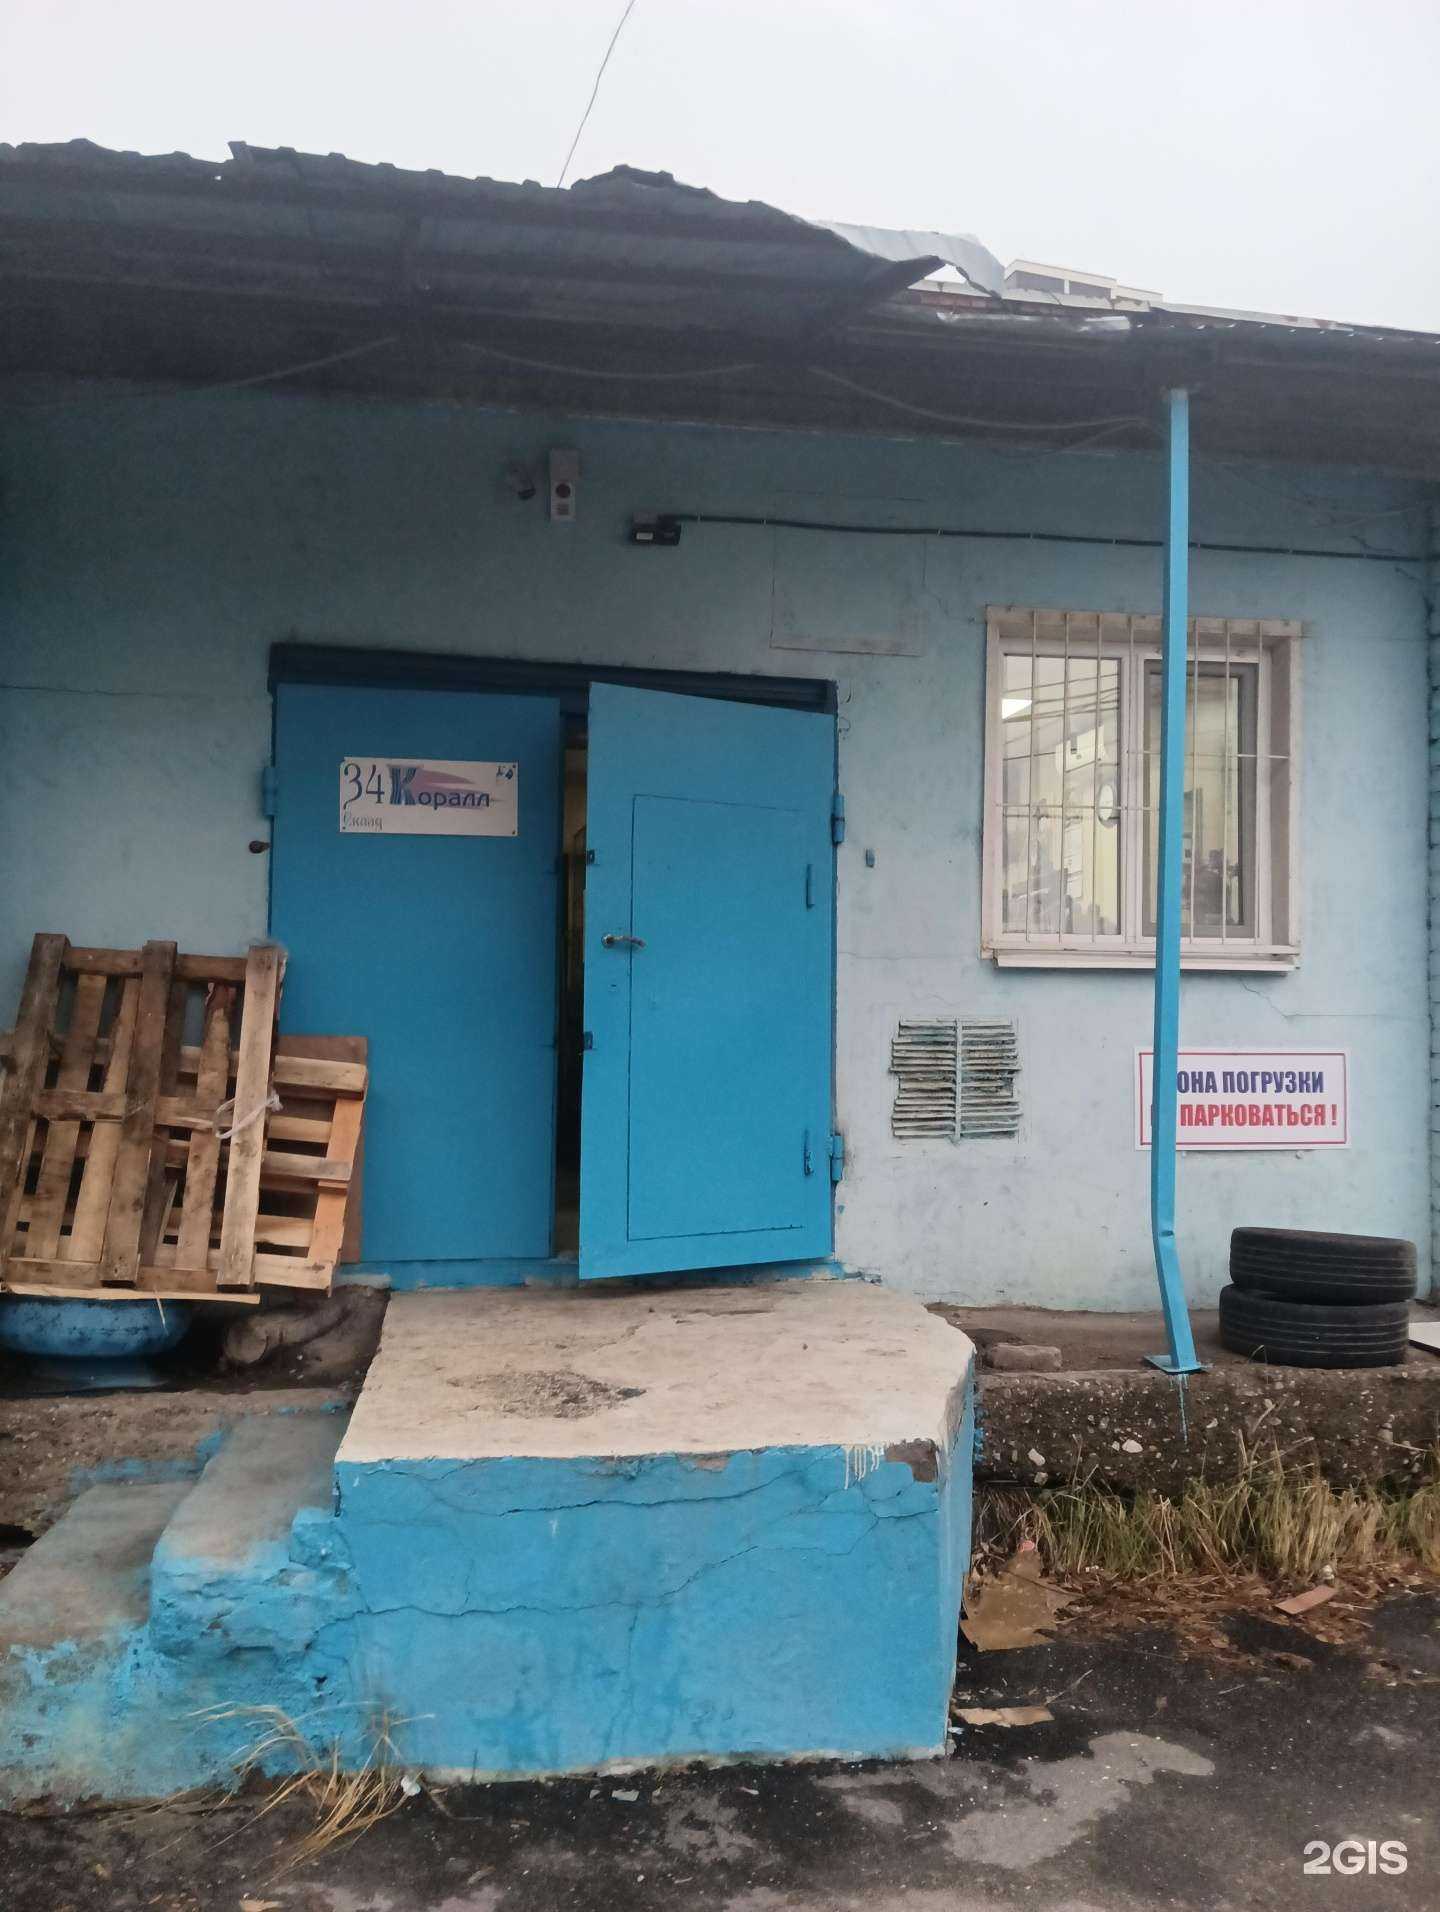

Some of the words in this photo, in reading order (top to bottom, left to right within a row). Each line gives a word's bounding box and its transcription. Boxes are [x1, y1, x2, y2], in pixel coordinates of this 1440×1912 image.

[343, 763, 385, 809] 34
[387, 764, 490, 810] Коралл
[1176, 1070, 1218, 1094] ОНА
[1222, 1070, 1324, 1094] ПОГРУЗКИ
[1180, 1103, 1326, 1127] ПАРКОВАТЬСЯ
